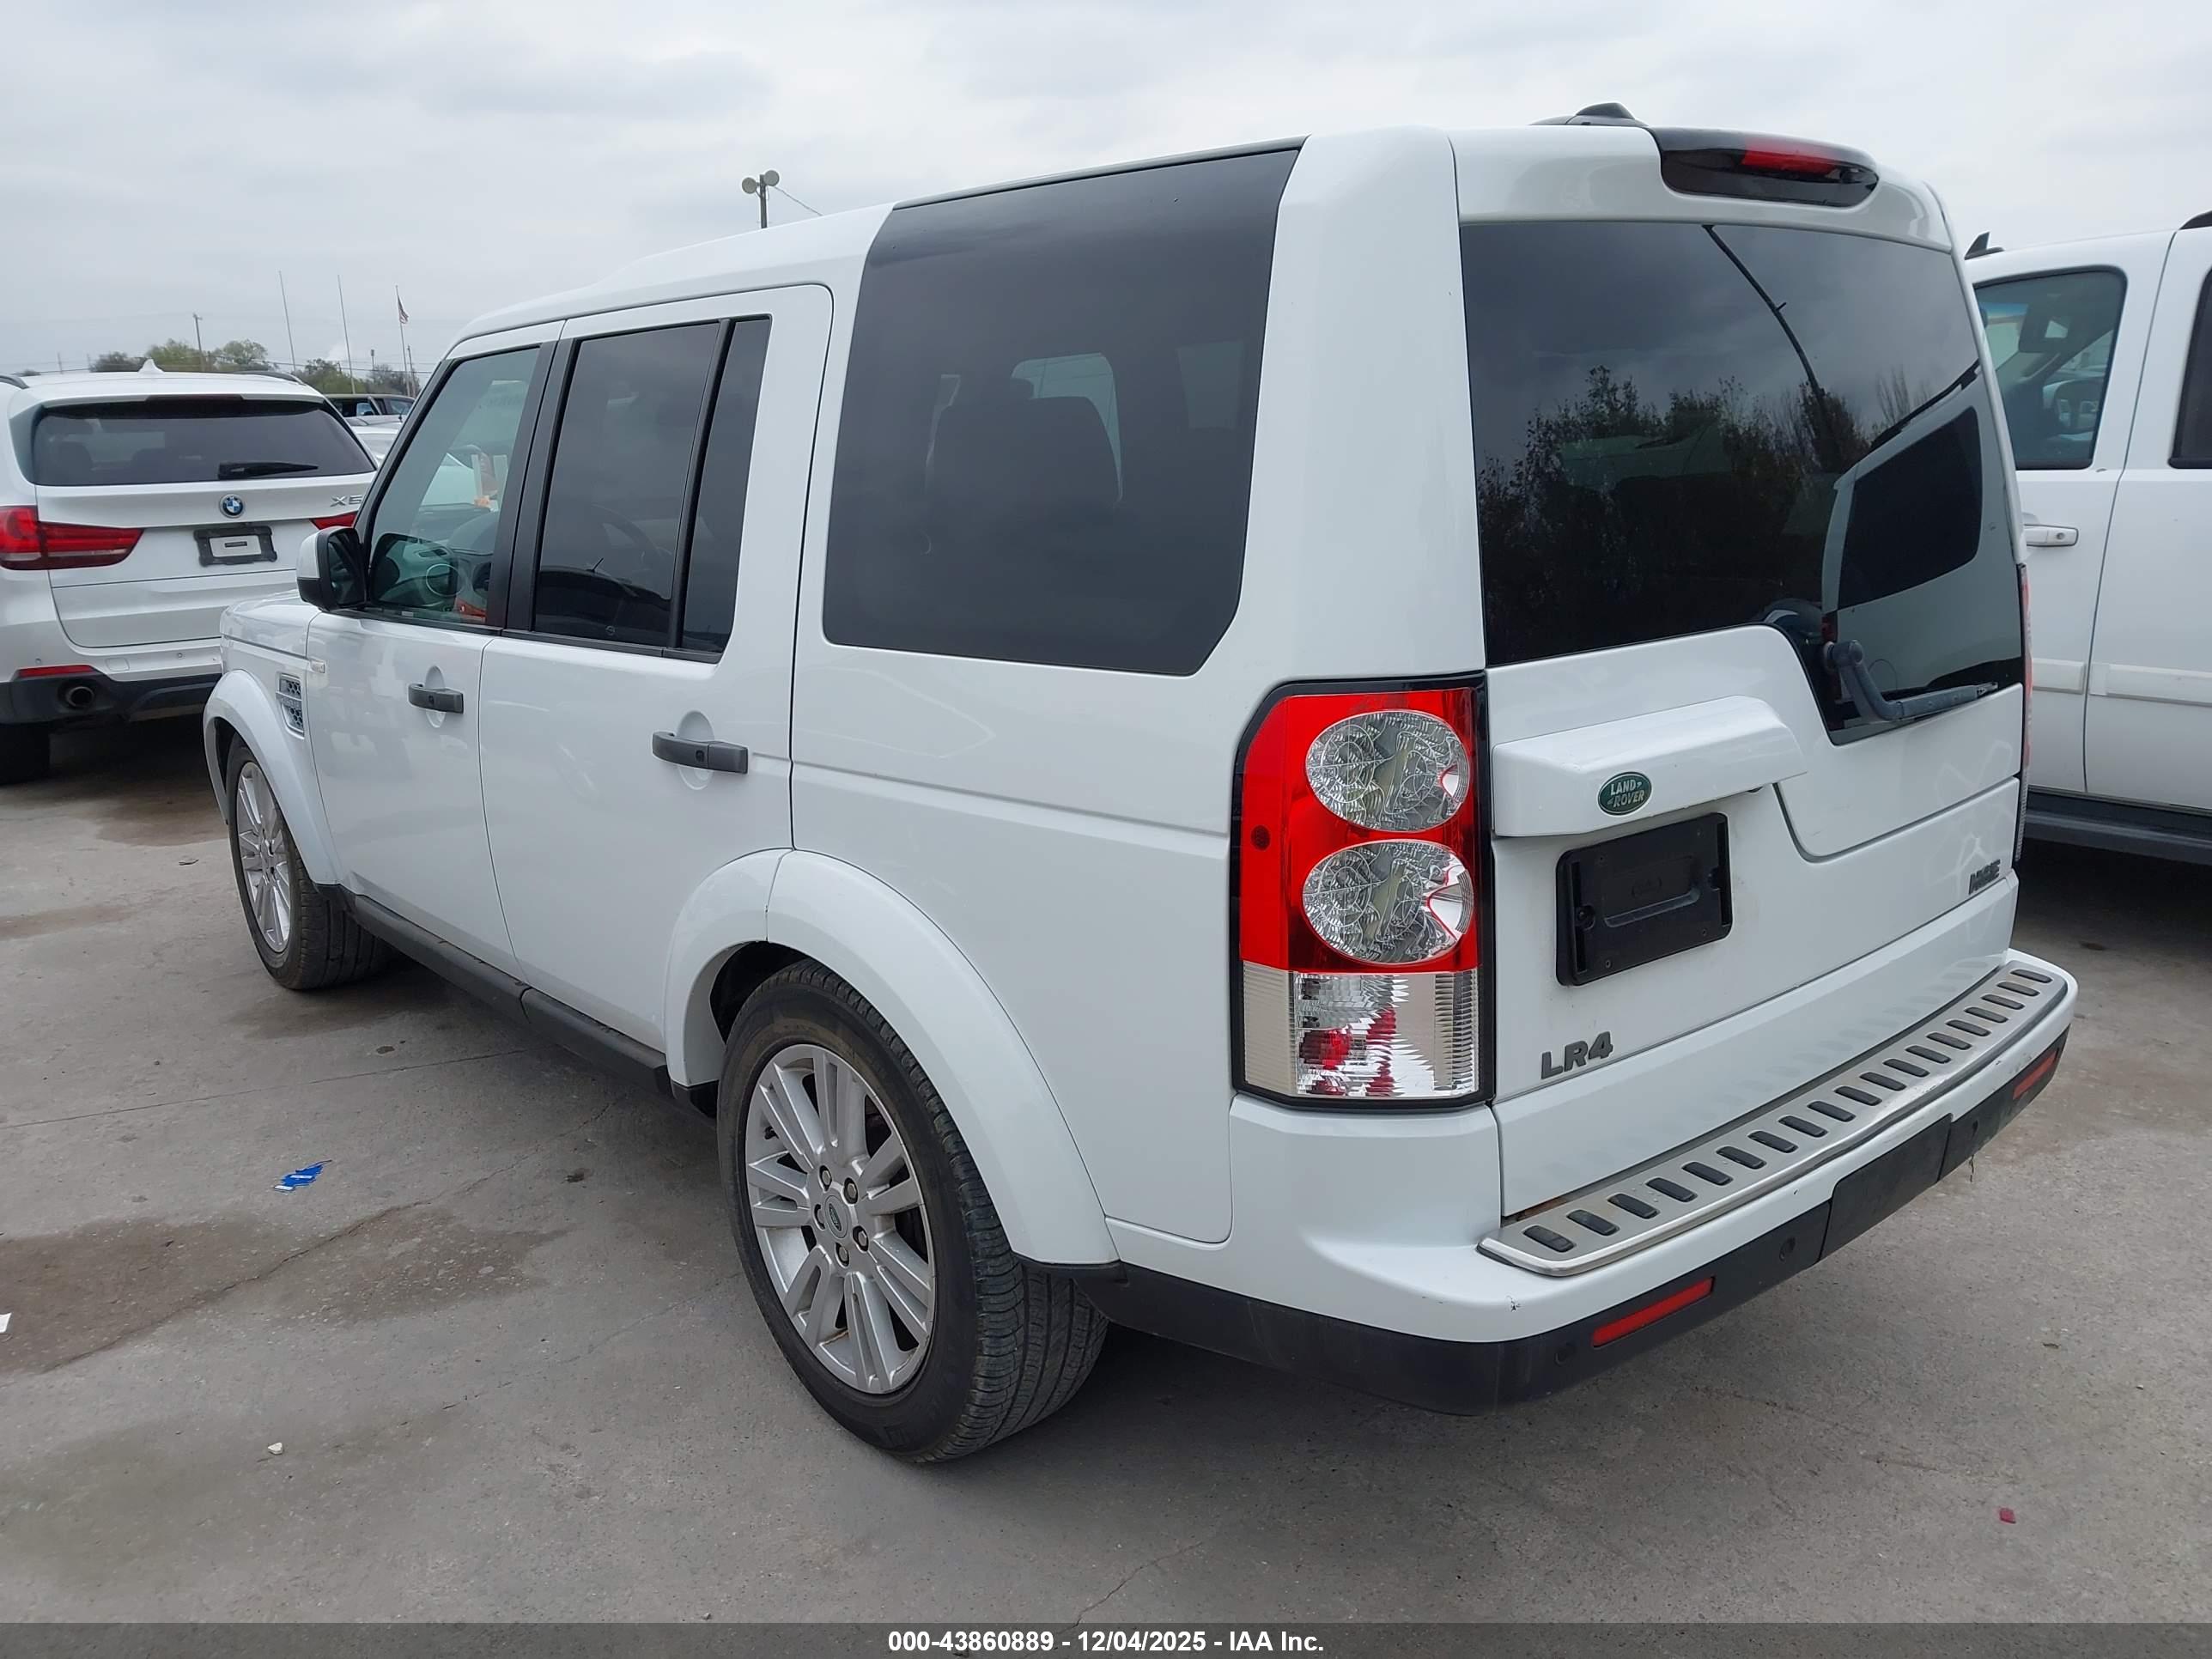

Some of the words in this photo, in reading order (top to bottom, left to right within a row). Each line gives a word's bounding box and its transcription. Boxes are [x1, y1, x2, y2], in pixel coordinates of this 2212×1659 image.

[1610, 779, 1637, 796] LAND
[1613, 790, 1644, 807] ROVER
[1541, 1031, 1613, 1079] LR4
